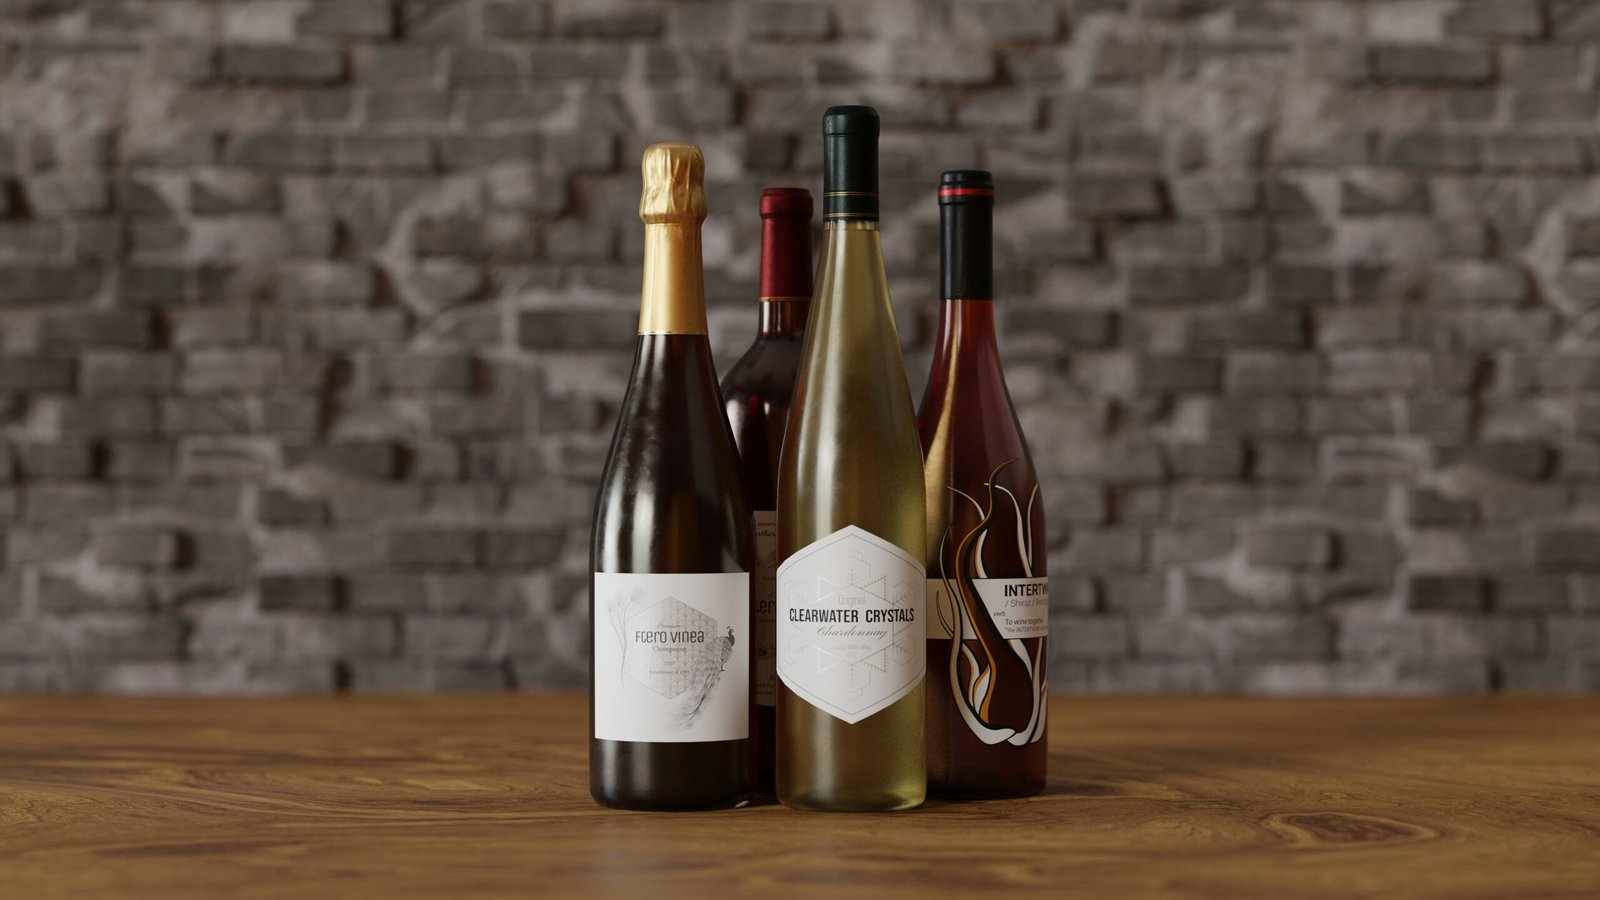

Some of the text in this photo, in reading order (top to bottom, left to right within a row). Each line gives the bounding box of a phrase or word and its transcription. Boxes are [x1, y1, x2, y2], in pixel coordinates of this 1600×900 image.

[1010, 599, 1032, 608] Shiraz
[789, 608, 915, 622] CLEARWATER CRYSTALS
[816, 625, 888, 640] Chardonnay
